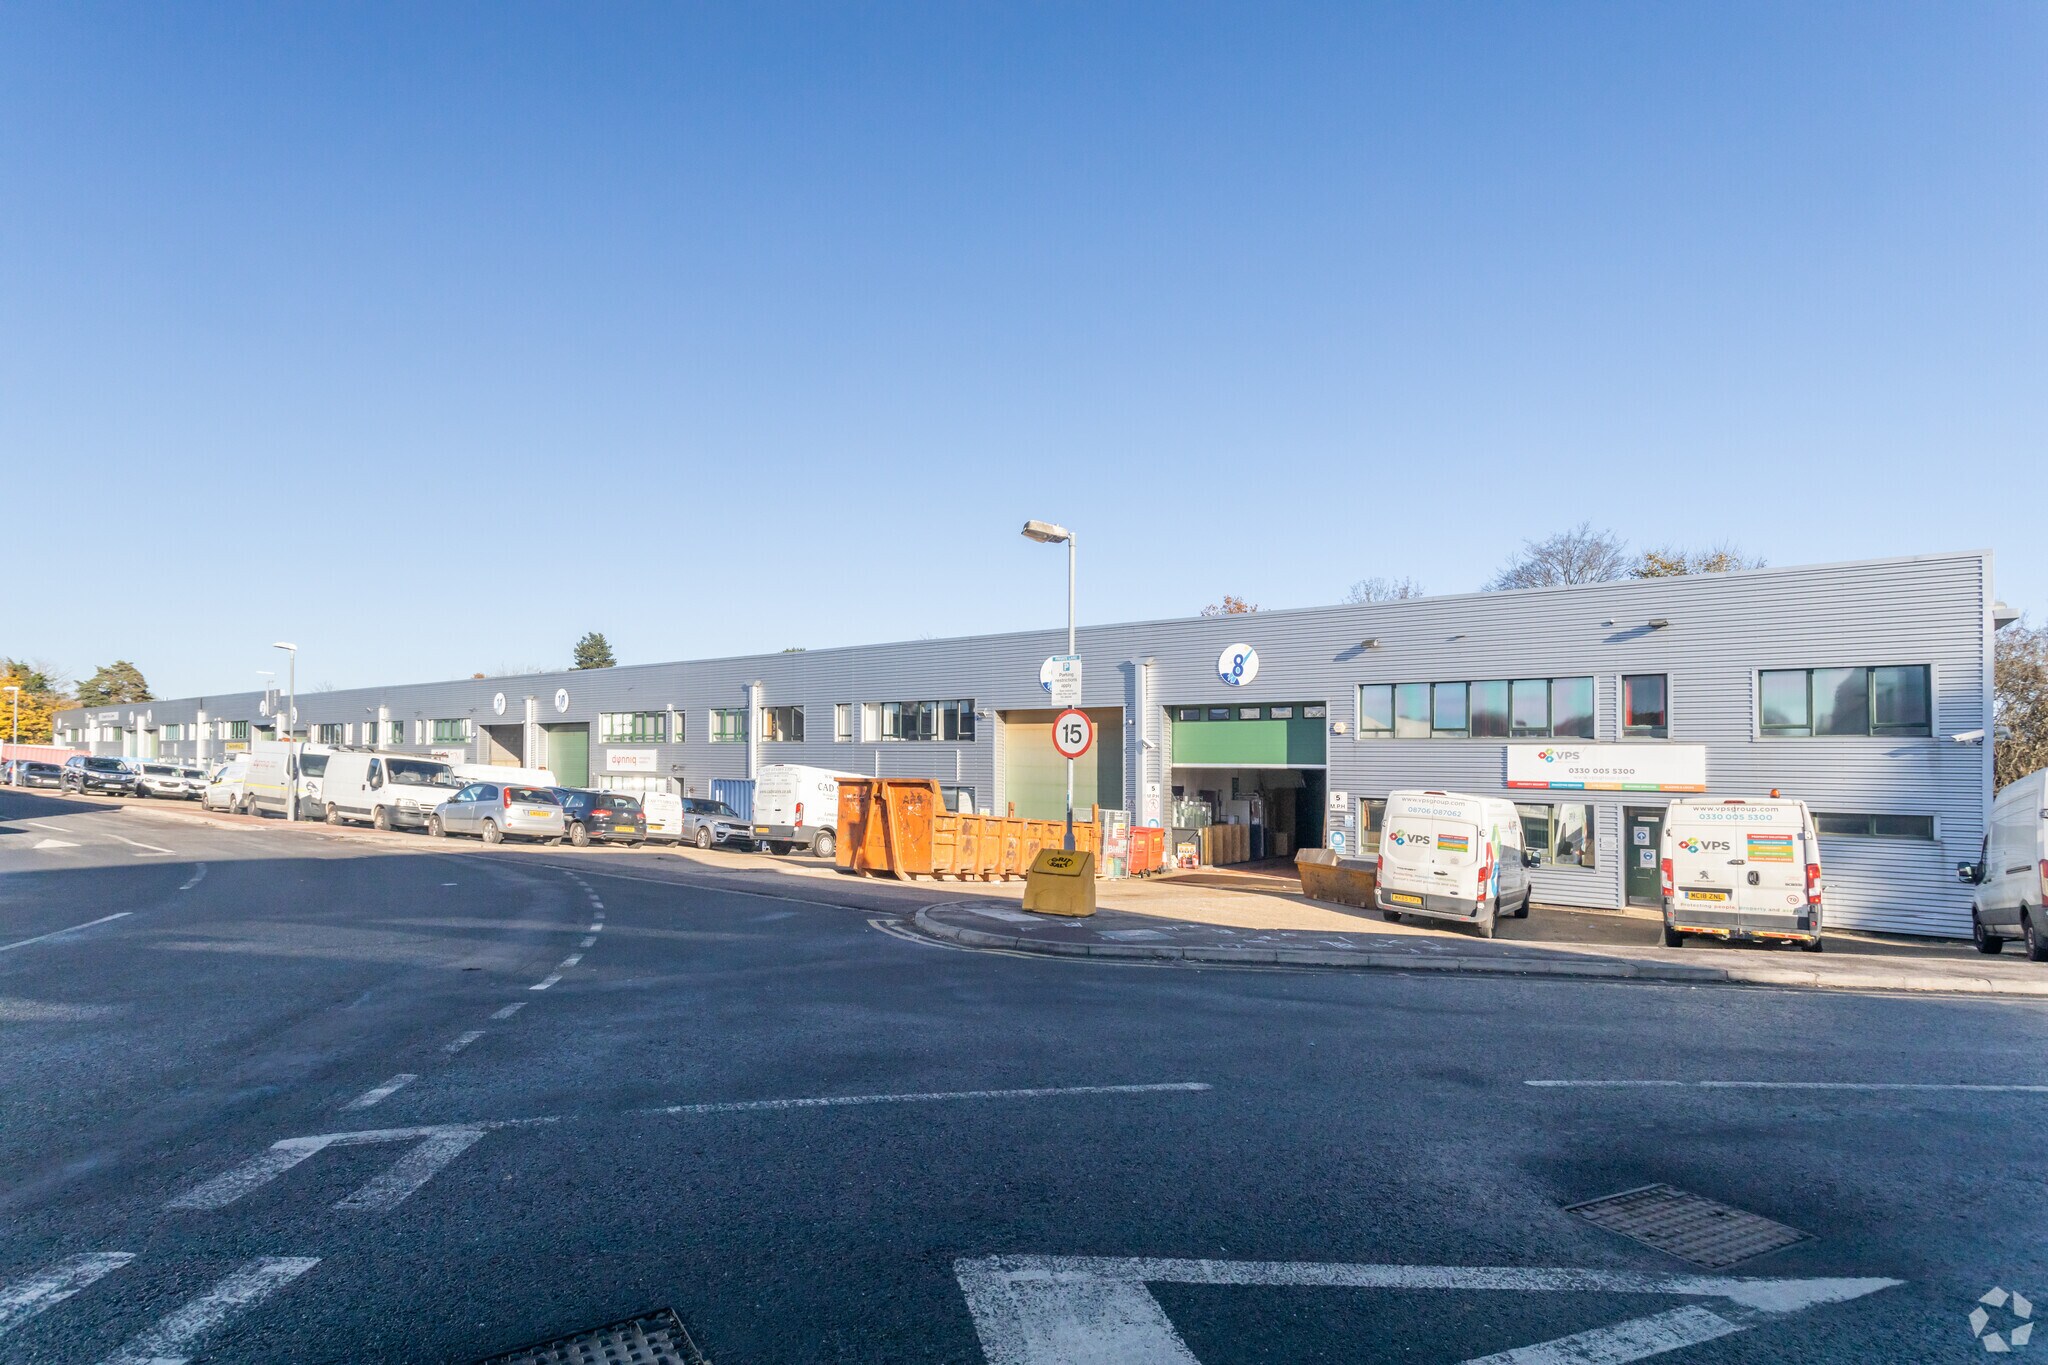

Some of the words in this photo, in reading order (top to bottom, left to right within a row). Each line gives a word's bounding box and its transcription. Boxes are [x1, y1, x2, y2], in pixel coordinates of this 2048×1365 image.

[1232, 653, 1244, 677] 8
[1062, 723, 1082, 744] 15
[1556, 751, 1580, 760] VPS
[817, 782, 835, 792] CAD
[1401, 796, 1466, 807] www.vpsgroup.com
[1408, 806, 1431, 814] 08706
[1432, 808, 1462, 817] 087062
[1725, 813, 1745, 821] 005
[1747, 813, 1773, 821] 5300
[1407, 834, 1430, 845] VPS
[1701, 841, 1731, 851] VPS
